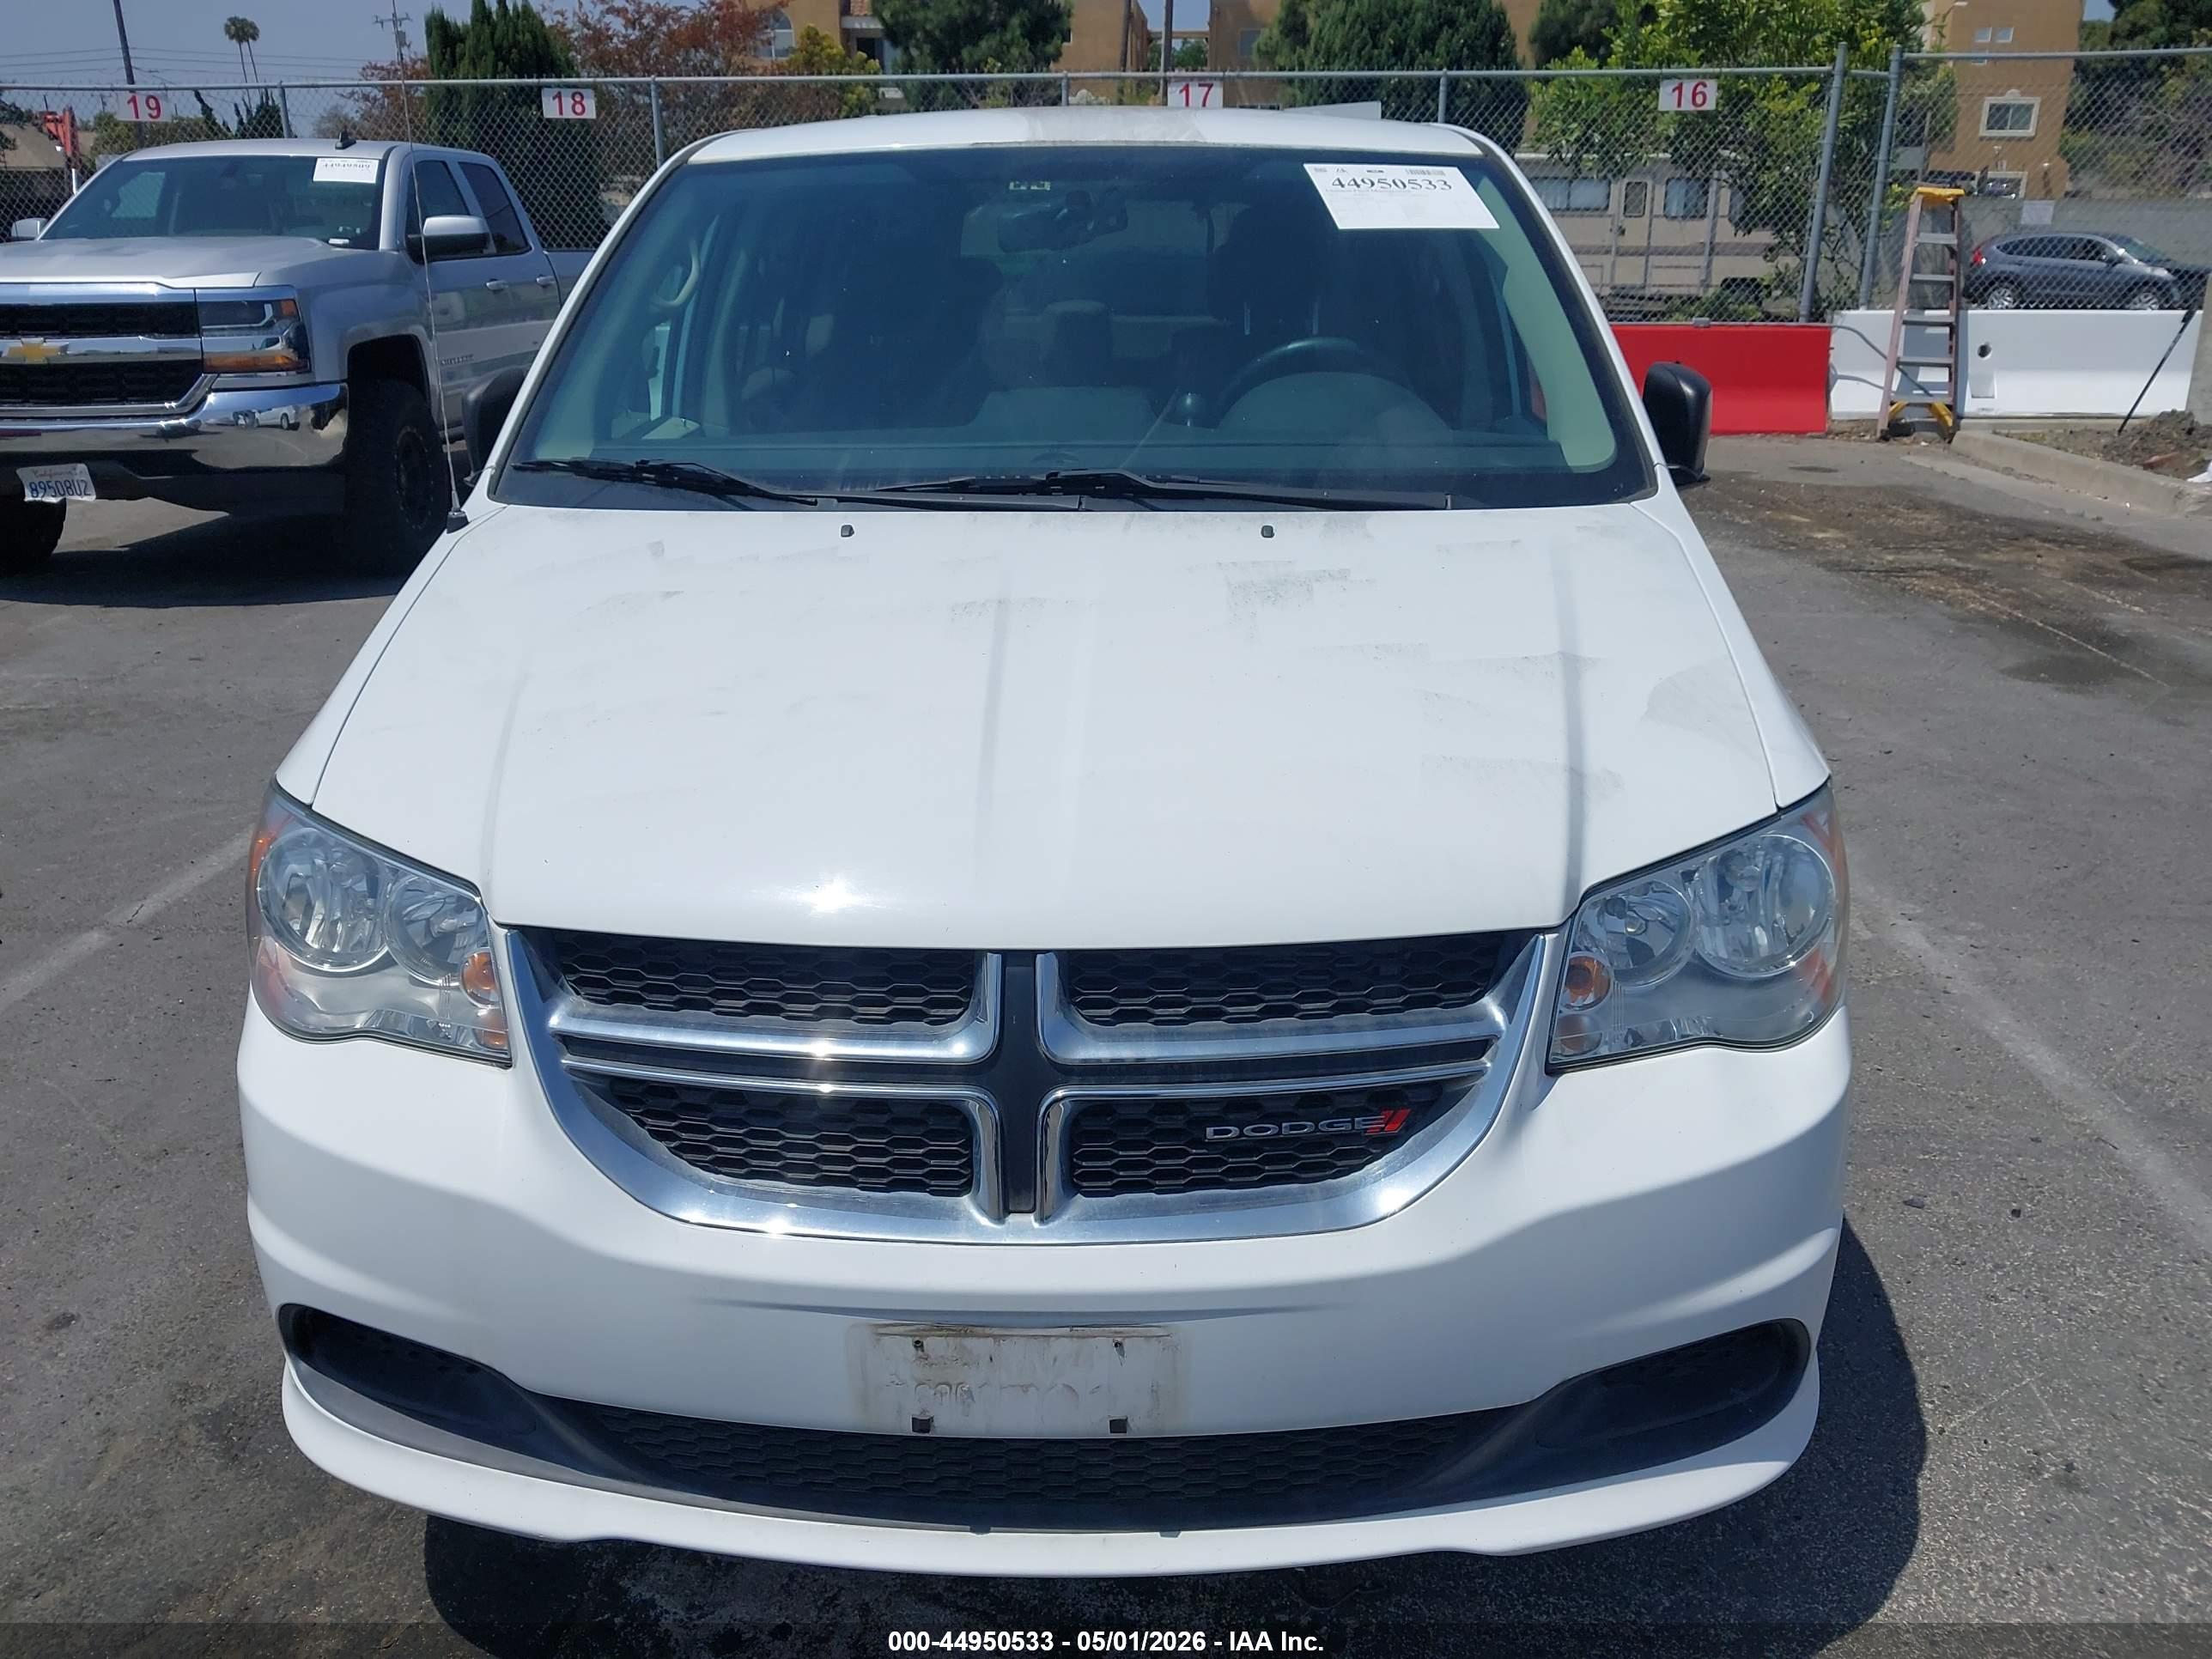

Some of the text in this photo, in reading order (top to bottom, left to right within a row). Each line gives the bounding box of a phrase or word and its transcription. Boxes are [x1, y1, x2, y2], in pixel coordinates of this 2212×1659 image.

[127, 94, 161, 119] 19
[552, 91, 586, 116] 18
[1179, 82, 1213, 107] 17
[1672, 81, 1707, 108] 16
[1332, 177, 1452, 191] 44950533
[28, 479, 92, 498] 89508U2
[1206, 1115, 1385, 1139] DODGE
